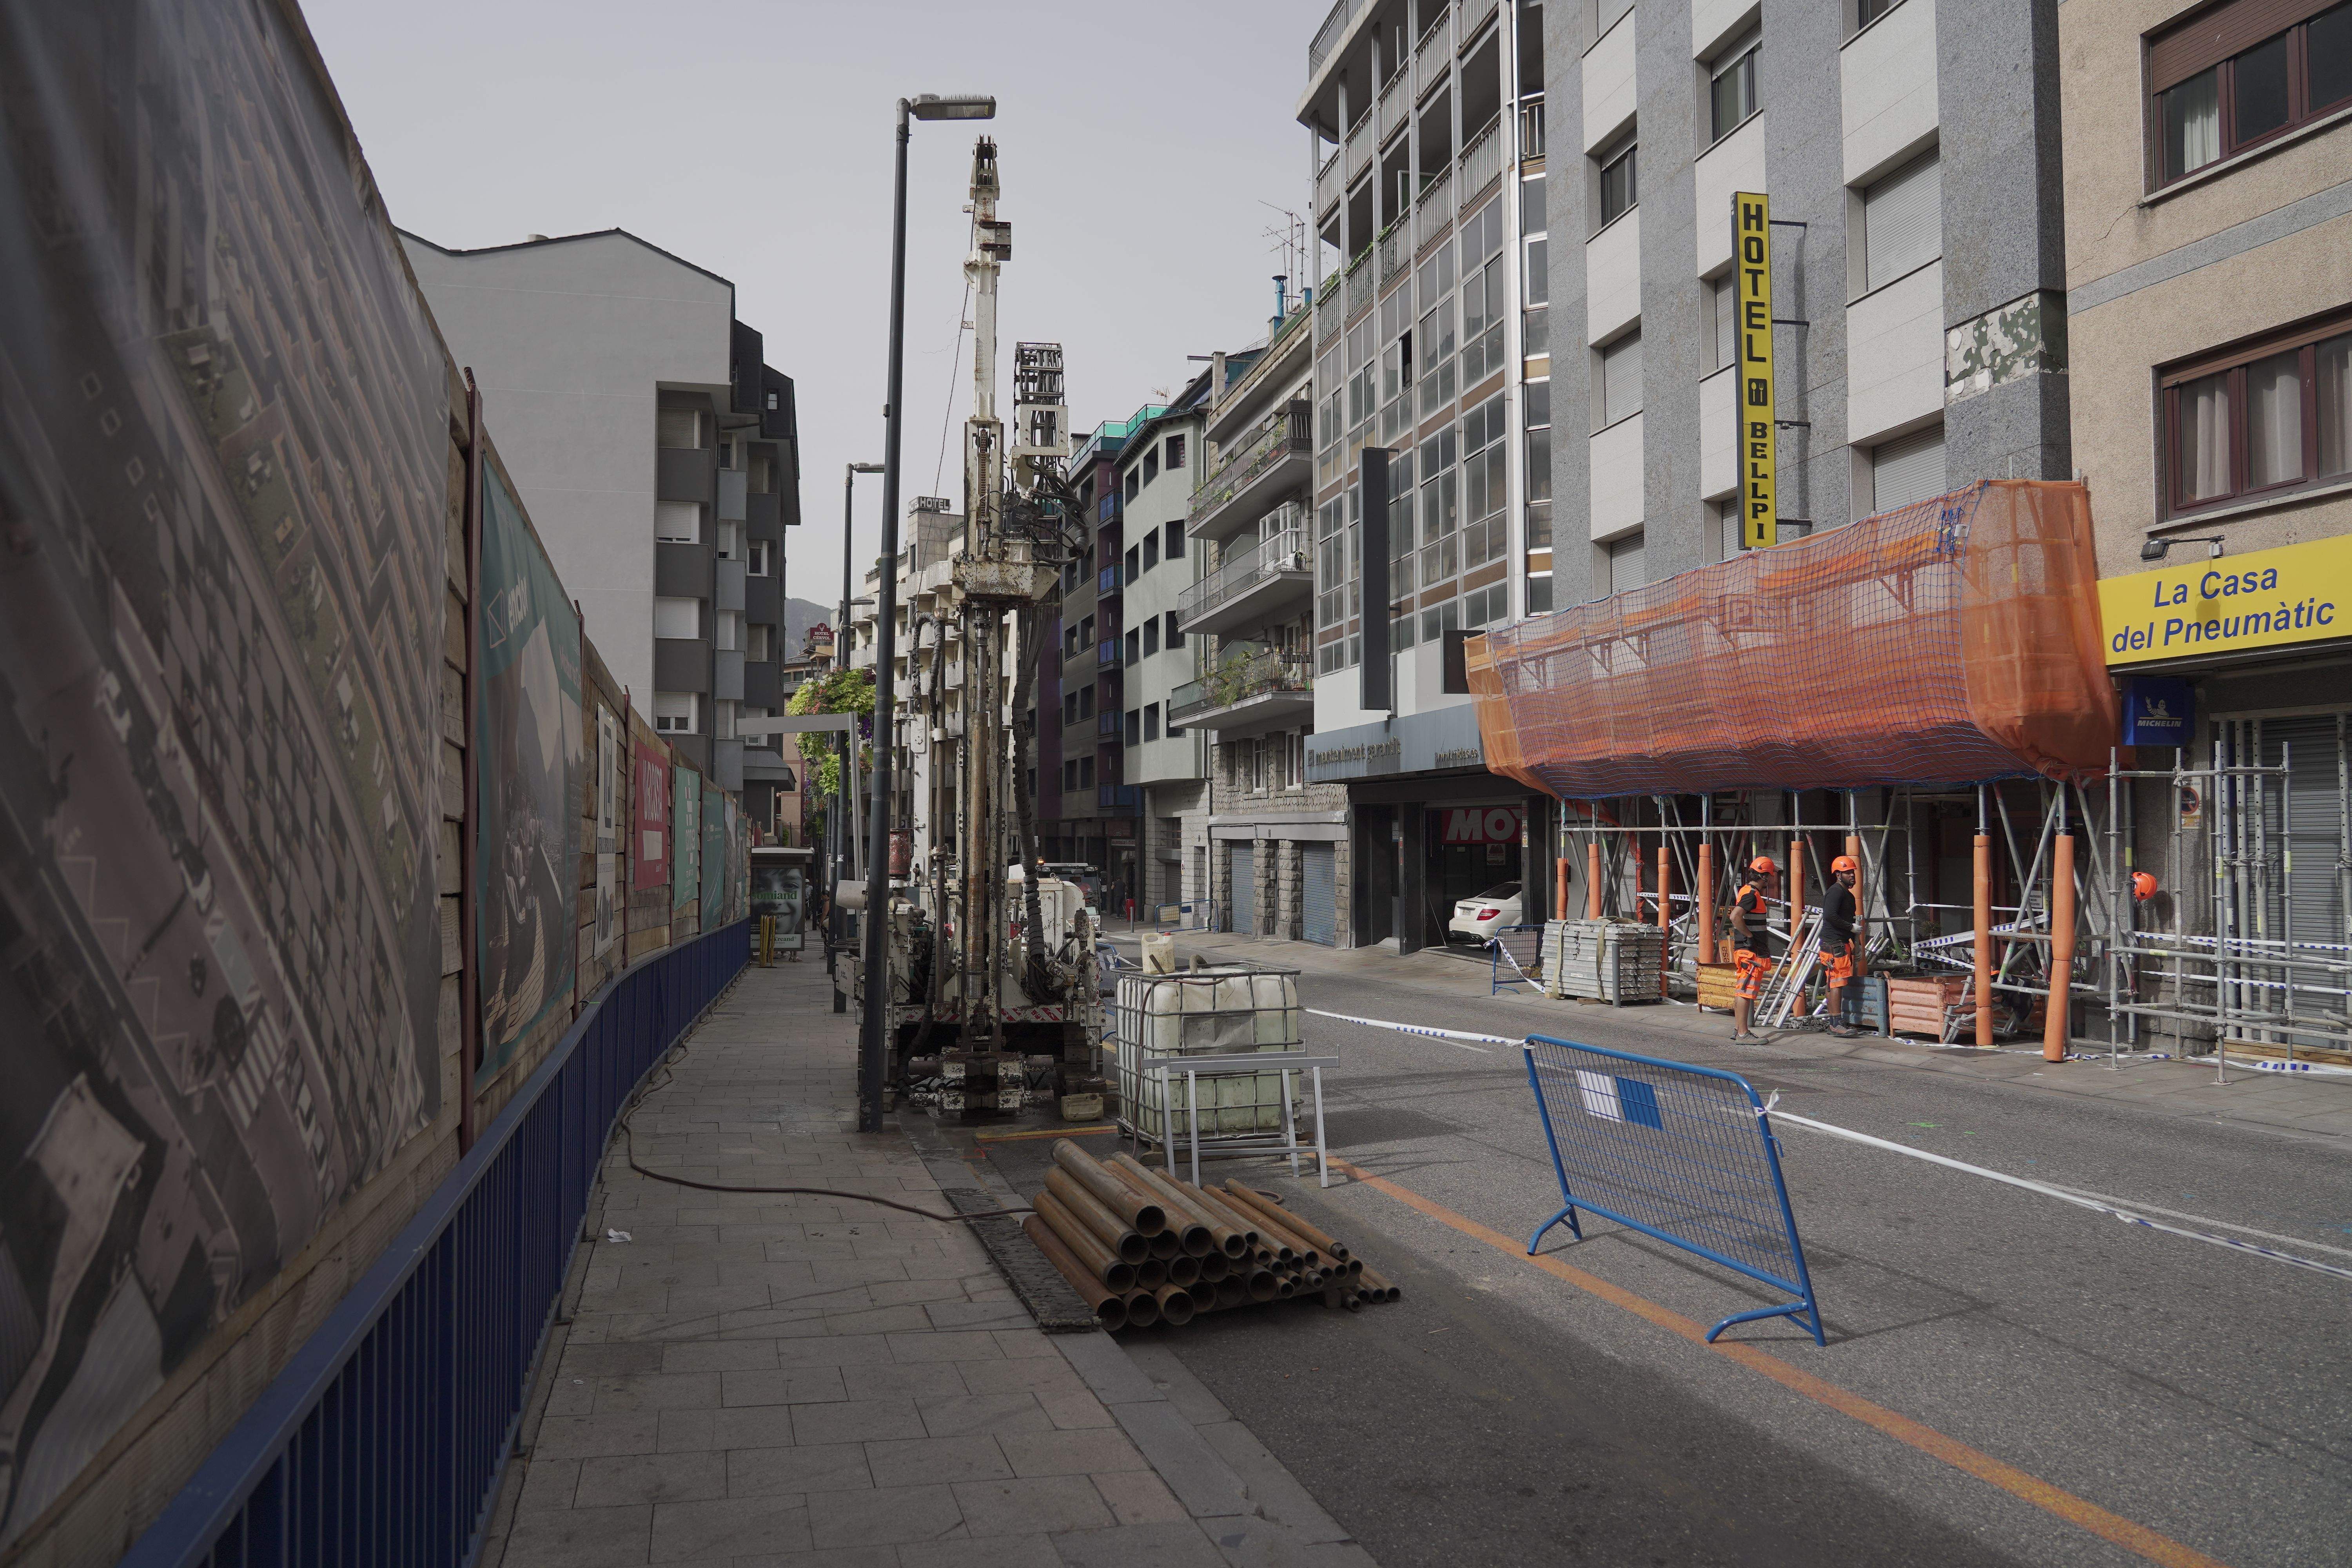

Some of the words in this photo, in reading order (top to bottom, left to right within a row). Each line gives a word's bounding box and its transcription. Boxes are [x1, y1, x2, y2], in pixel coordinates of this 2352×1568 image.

[1743, 203, 1766, 363] HOTEL
[920, 497, 949, 509] HOTEL
[1750, 421, 1769, 540] BELLPI
[508, 572, 528, 634] endor
[2153, 581, 2188, 608] La
[2200, 568, 2278, 600] Casa
[2112, 622, 2154, 653] del
[2163, 597, 2335, 646] Pneumàtic
[1316, 742, 1366, 766] manteniment
[1367, 736, 1401, 764] garantit
[1434, 746, 1478, 762] www.midas.es
